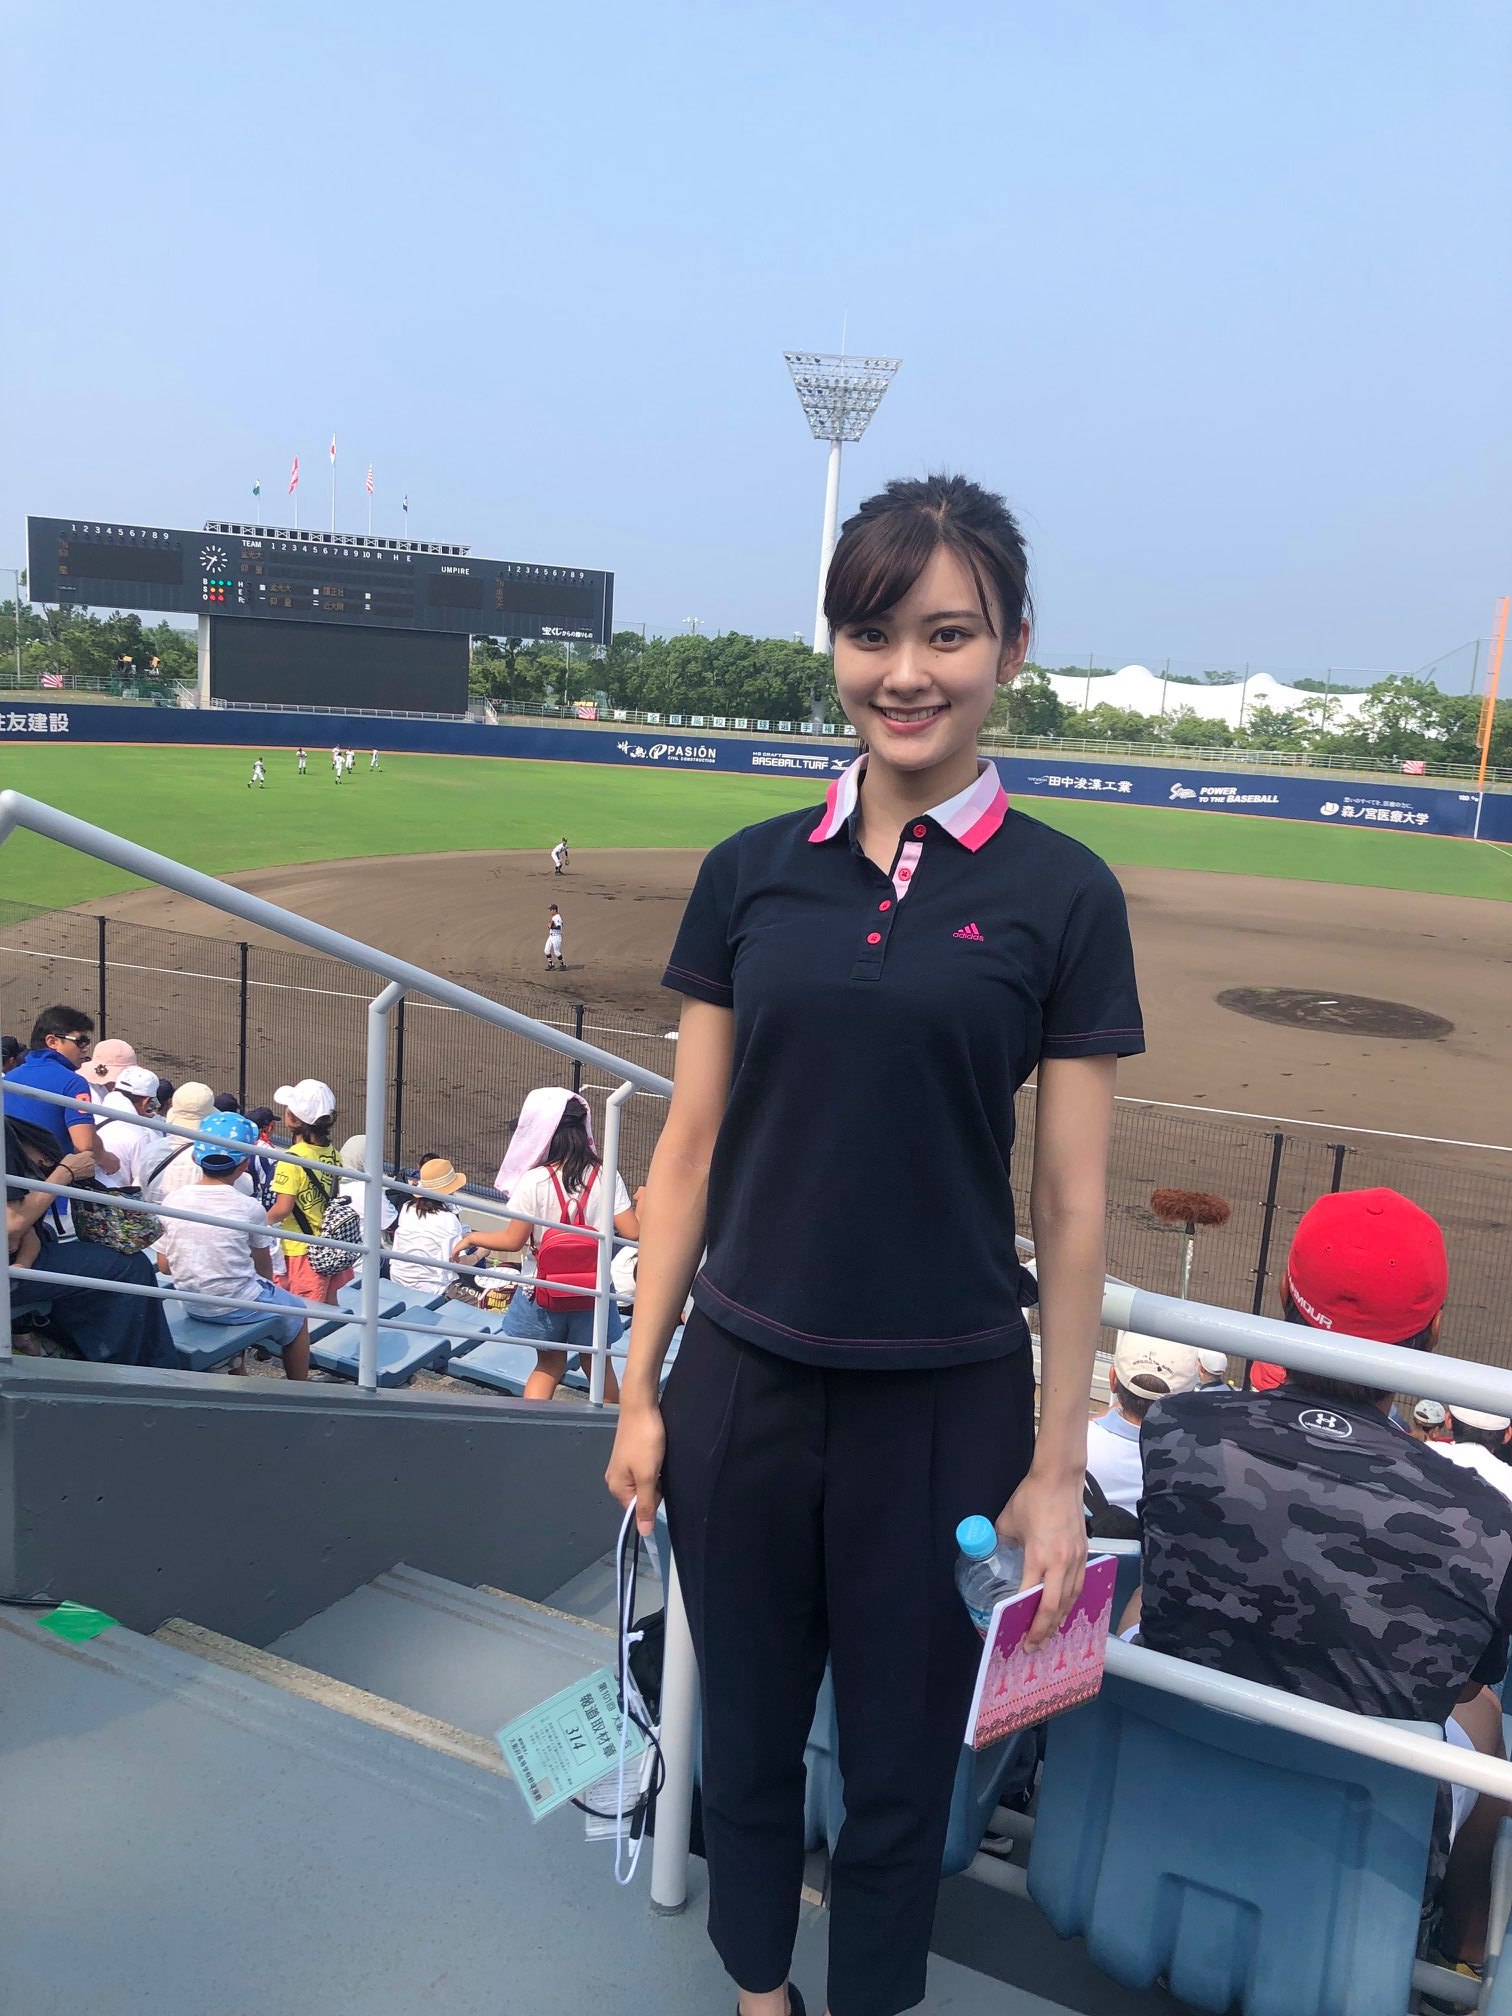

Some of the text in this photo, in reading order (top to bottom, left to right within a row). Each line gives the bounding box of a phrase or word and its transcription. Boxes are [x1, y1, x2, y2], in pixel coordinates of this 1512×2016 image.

[441, 566, 470, 575] UMPIRE
[752, 757, 802, 768] BASEBALL
[803, 760, 828, 770] TURF
[1200, 787, 1237, 795] POWER
[1226, 795, 1279, 803] BASEBALL
[1341, 805, 1429, 826] 森ノ宮医療大学
[952, 932, 984, 942] adidas
[580, 1693, 617, 1758] 報道取材章
[566, 1726, 587, 1750] 314
